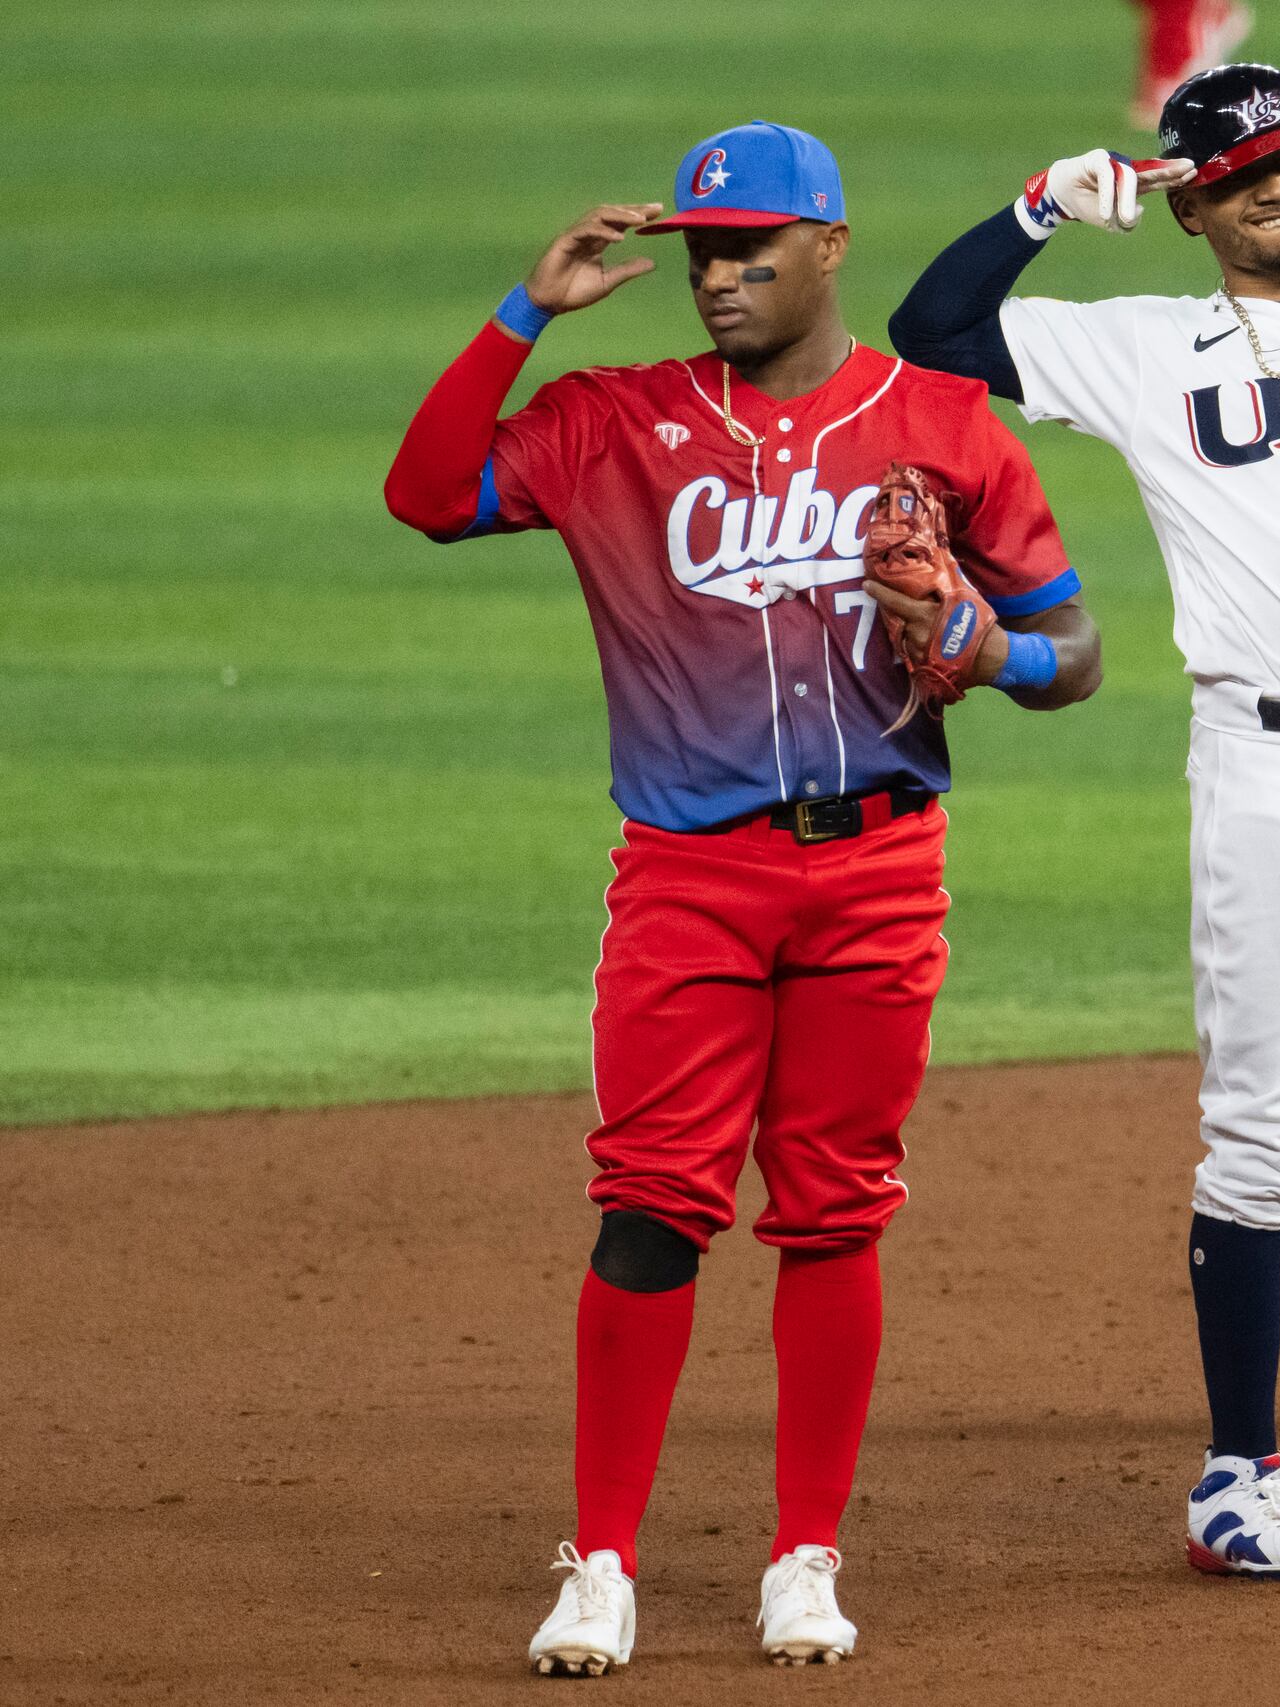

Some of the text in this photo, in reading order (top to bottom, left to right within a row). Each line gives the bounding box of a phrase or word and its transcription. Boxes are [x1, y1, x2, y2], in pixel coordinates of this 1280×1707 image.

[691, 148, 726, 198] C
[834, 590, 879, 672] 7
[943, 600, 975, 656] Wilson
